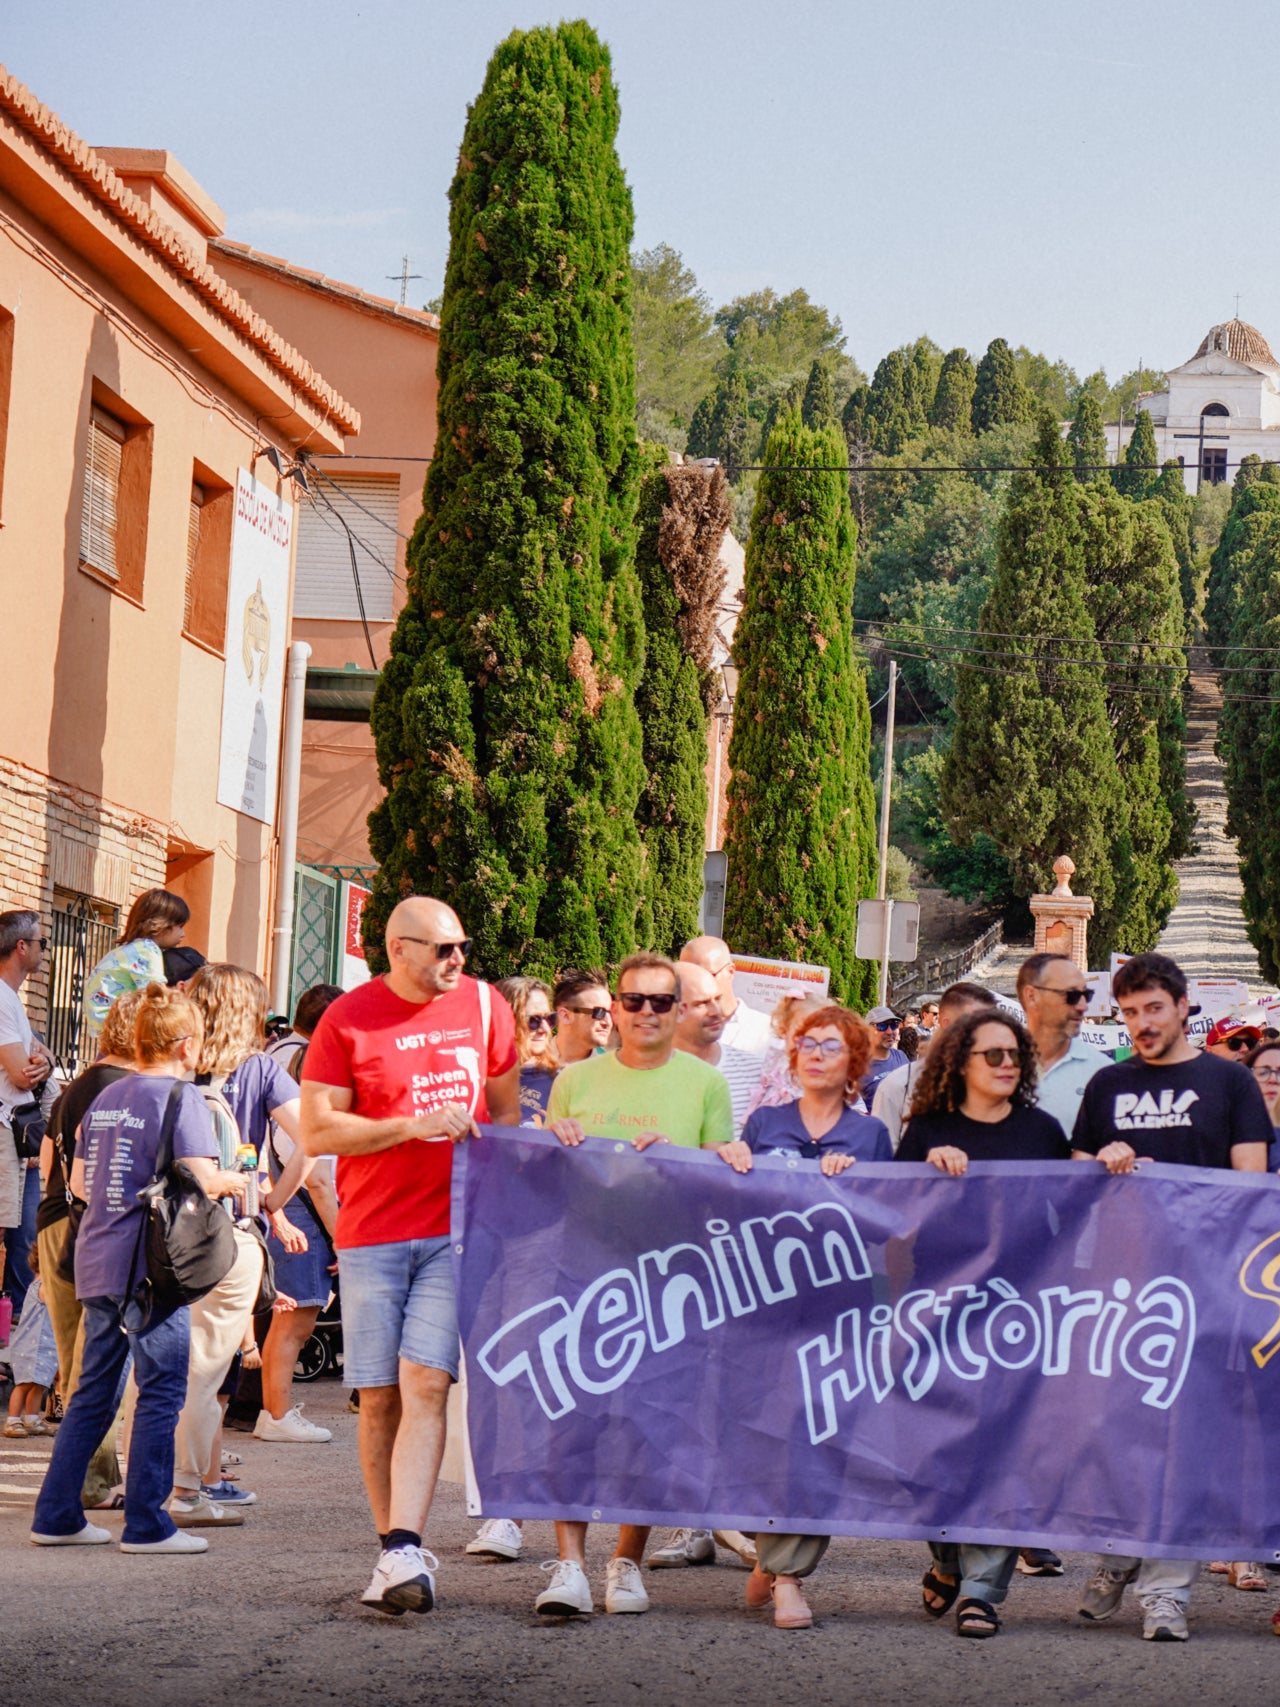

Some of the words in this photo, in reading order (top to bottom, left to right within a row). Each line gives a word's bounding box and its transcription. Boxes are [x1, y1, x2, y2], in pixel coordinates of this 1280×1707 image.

[237, 484, 260, 528] ESCOLA
[395, 1032, 427, 1051] UGT
[222, 1082, 240, 1094] 026
[411, 1069, 467, 1089] Salvem
[412, 1083, 469, 1105] l'escola
[475, 1200, 874, 1421] Tenim
[796, 1274, 1198, 1446] Història
